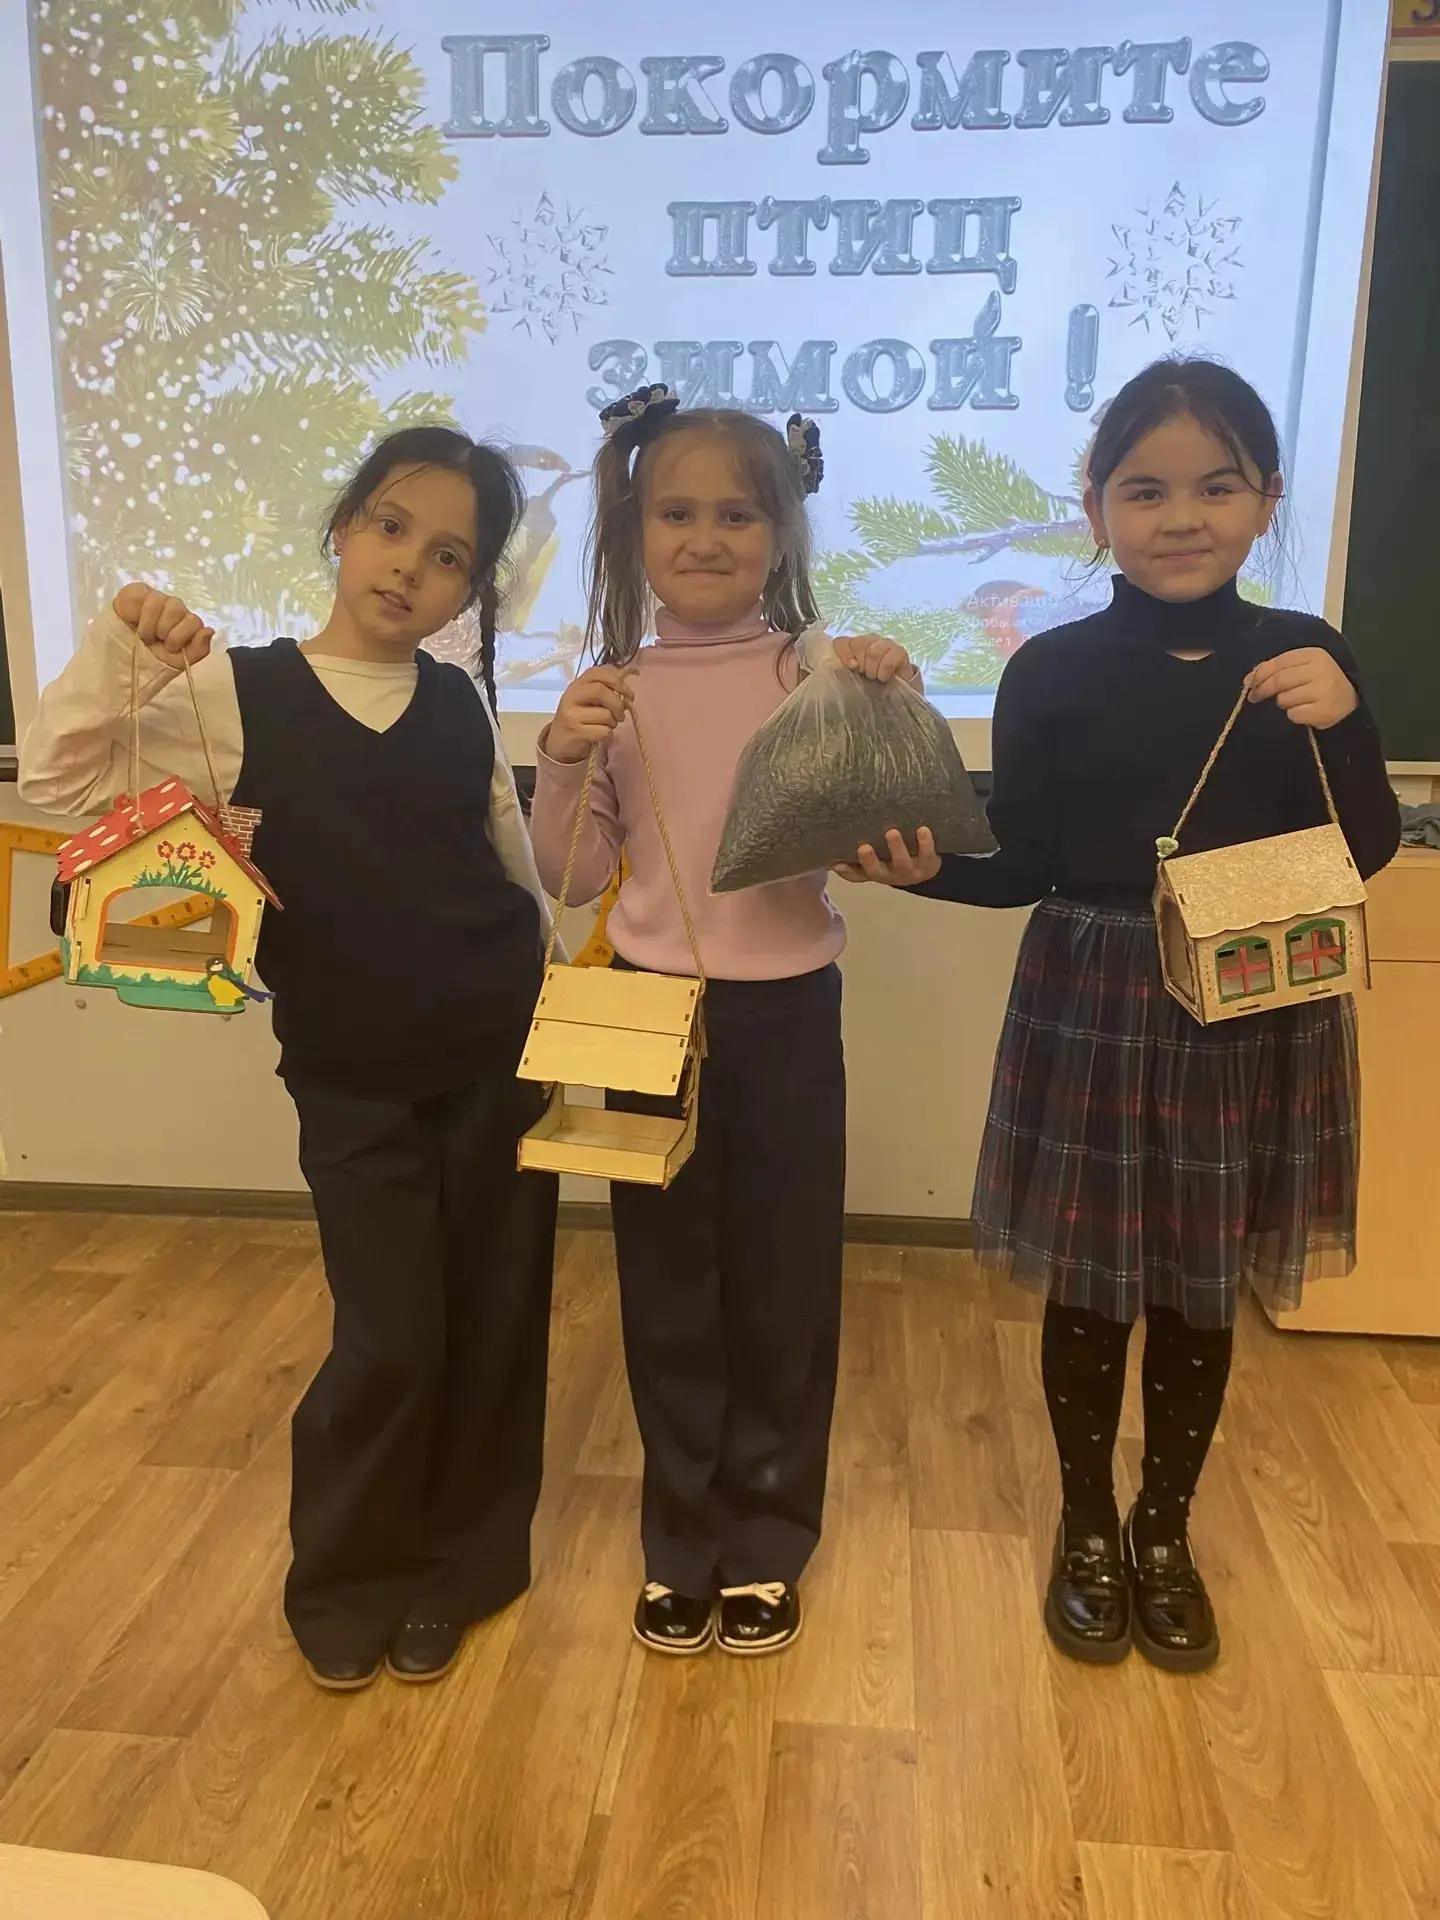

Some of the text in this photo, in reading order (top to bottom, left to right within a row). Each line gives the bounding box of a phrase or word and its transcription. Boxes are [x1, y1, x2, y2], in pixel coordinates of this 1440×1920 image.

[440, 33, 1271, 166] Покормите
[665, 195, 1022, 295] птиц
[586, 290, 1022, 415] зимой
